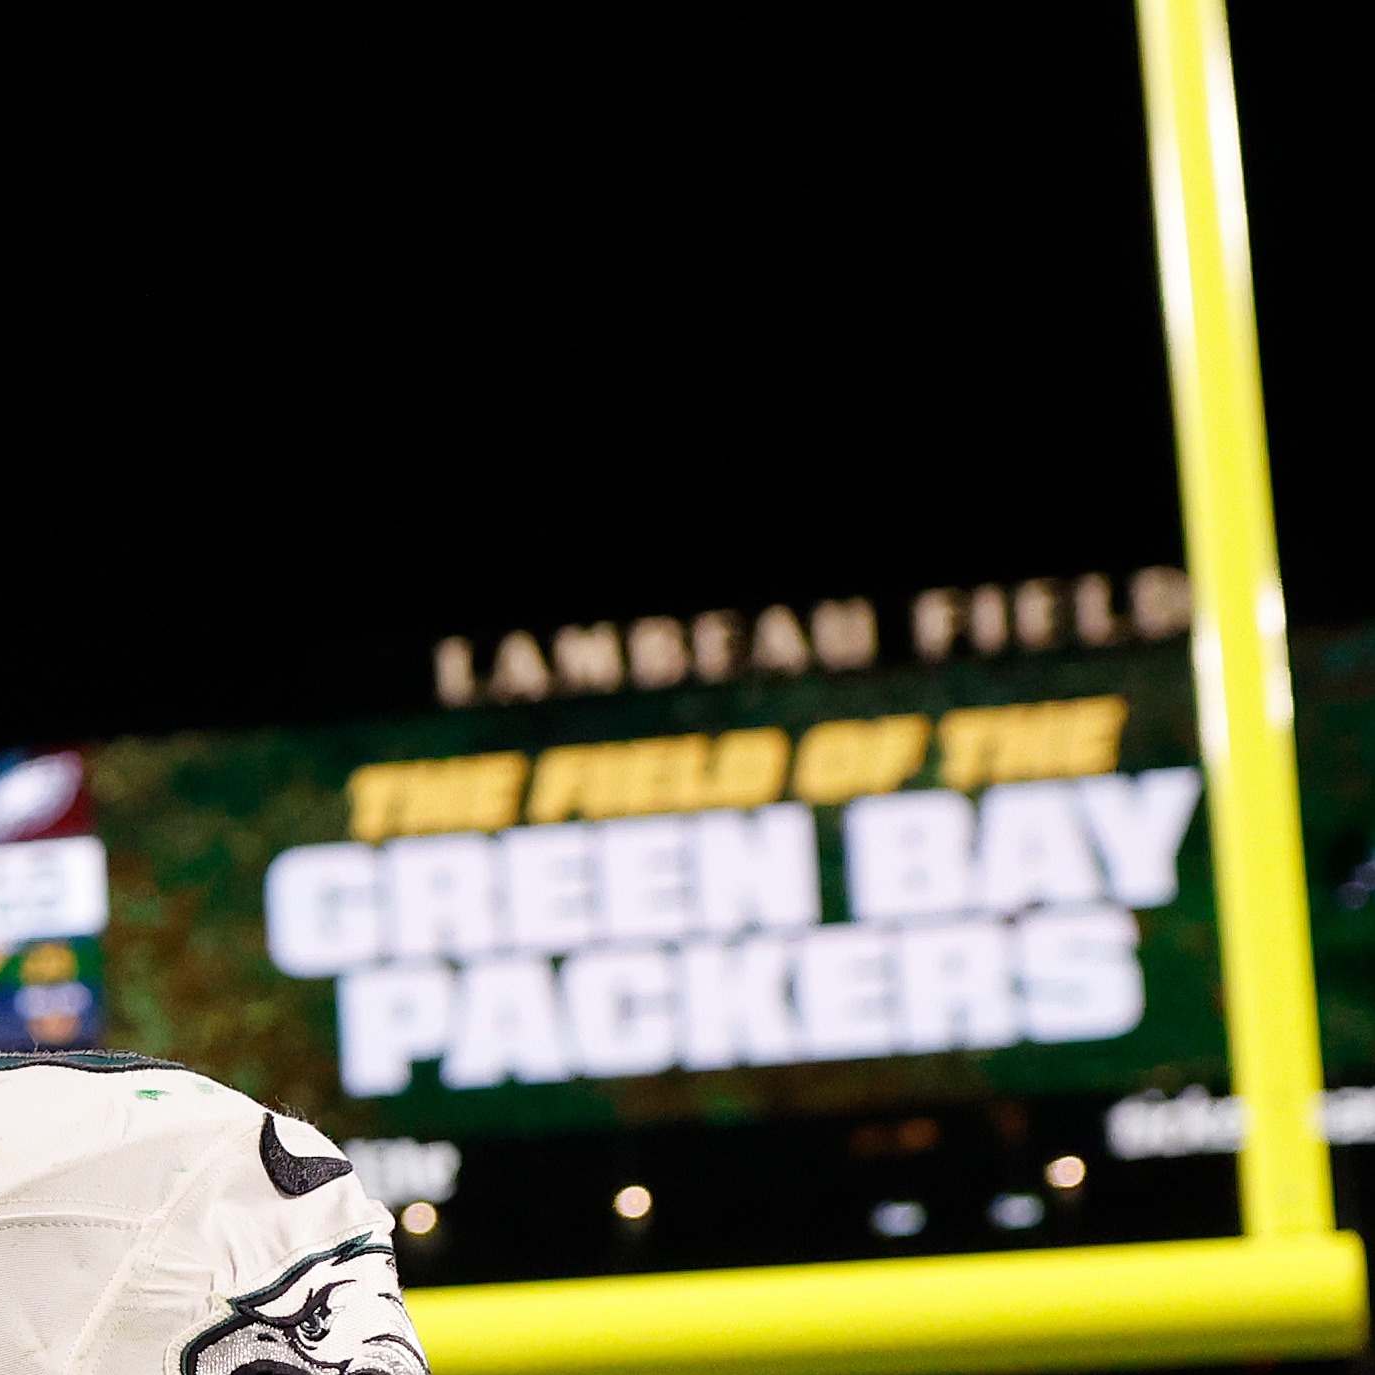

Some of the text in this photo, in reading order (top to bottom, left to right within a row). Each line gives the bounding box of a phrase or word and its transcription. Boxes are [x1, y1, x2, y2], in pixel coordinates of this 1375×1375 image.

[434, 564, 1191, 707] LAMBEAU FIELD
[350, 695, 1129, 845] THE FIELD OF THE
[264, 801, 821, 979] GREEN
[843, 766, 1204, 925] BAY
[335, 902, 1146, 1098] PACKERS
